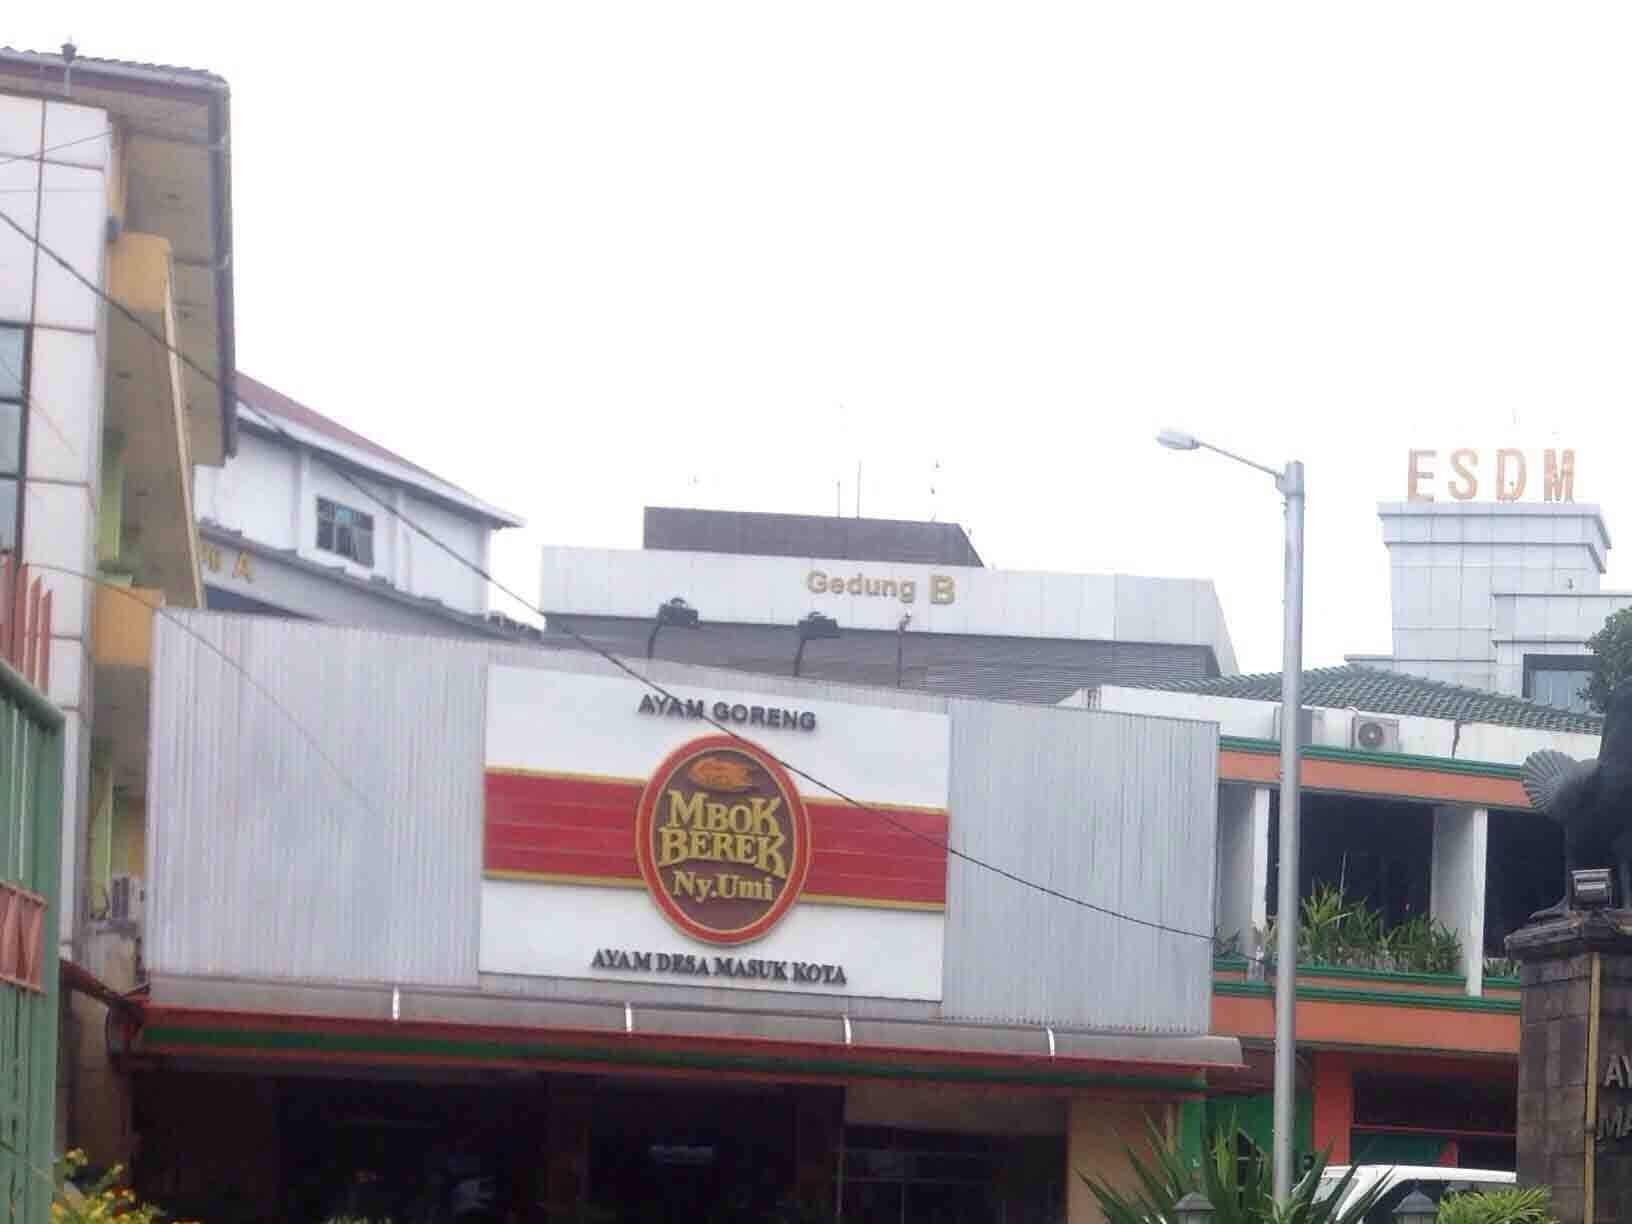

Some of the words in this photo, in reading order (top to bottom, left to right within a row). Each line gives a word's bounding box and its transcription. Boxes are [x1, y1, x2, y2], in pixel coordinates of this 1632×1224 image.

[1406, 448, 1576, 502] ESDM
[806, 570, 917, 603] Gedung
[929, 575, 955, 605] B
[637, 693, 705, 719] AYAM
[712, 702, 817, 732] GORENG
[657, 826, 787, 878] BEREK
[591, 948, 652, 971] AYAM
[656, 953, 710, 976] DESA
[713, 957, 788, 981] MASUK
[792, 962, 848, 986] KOTA
